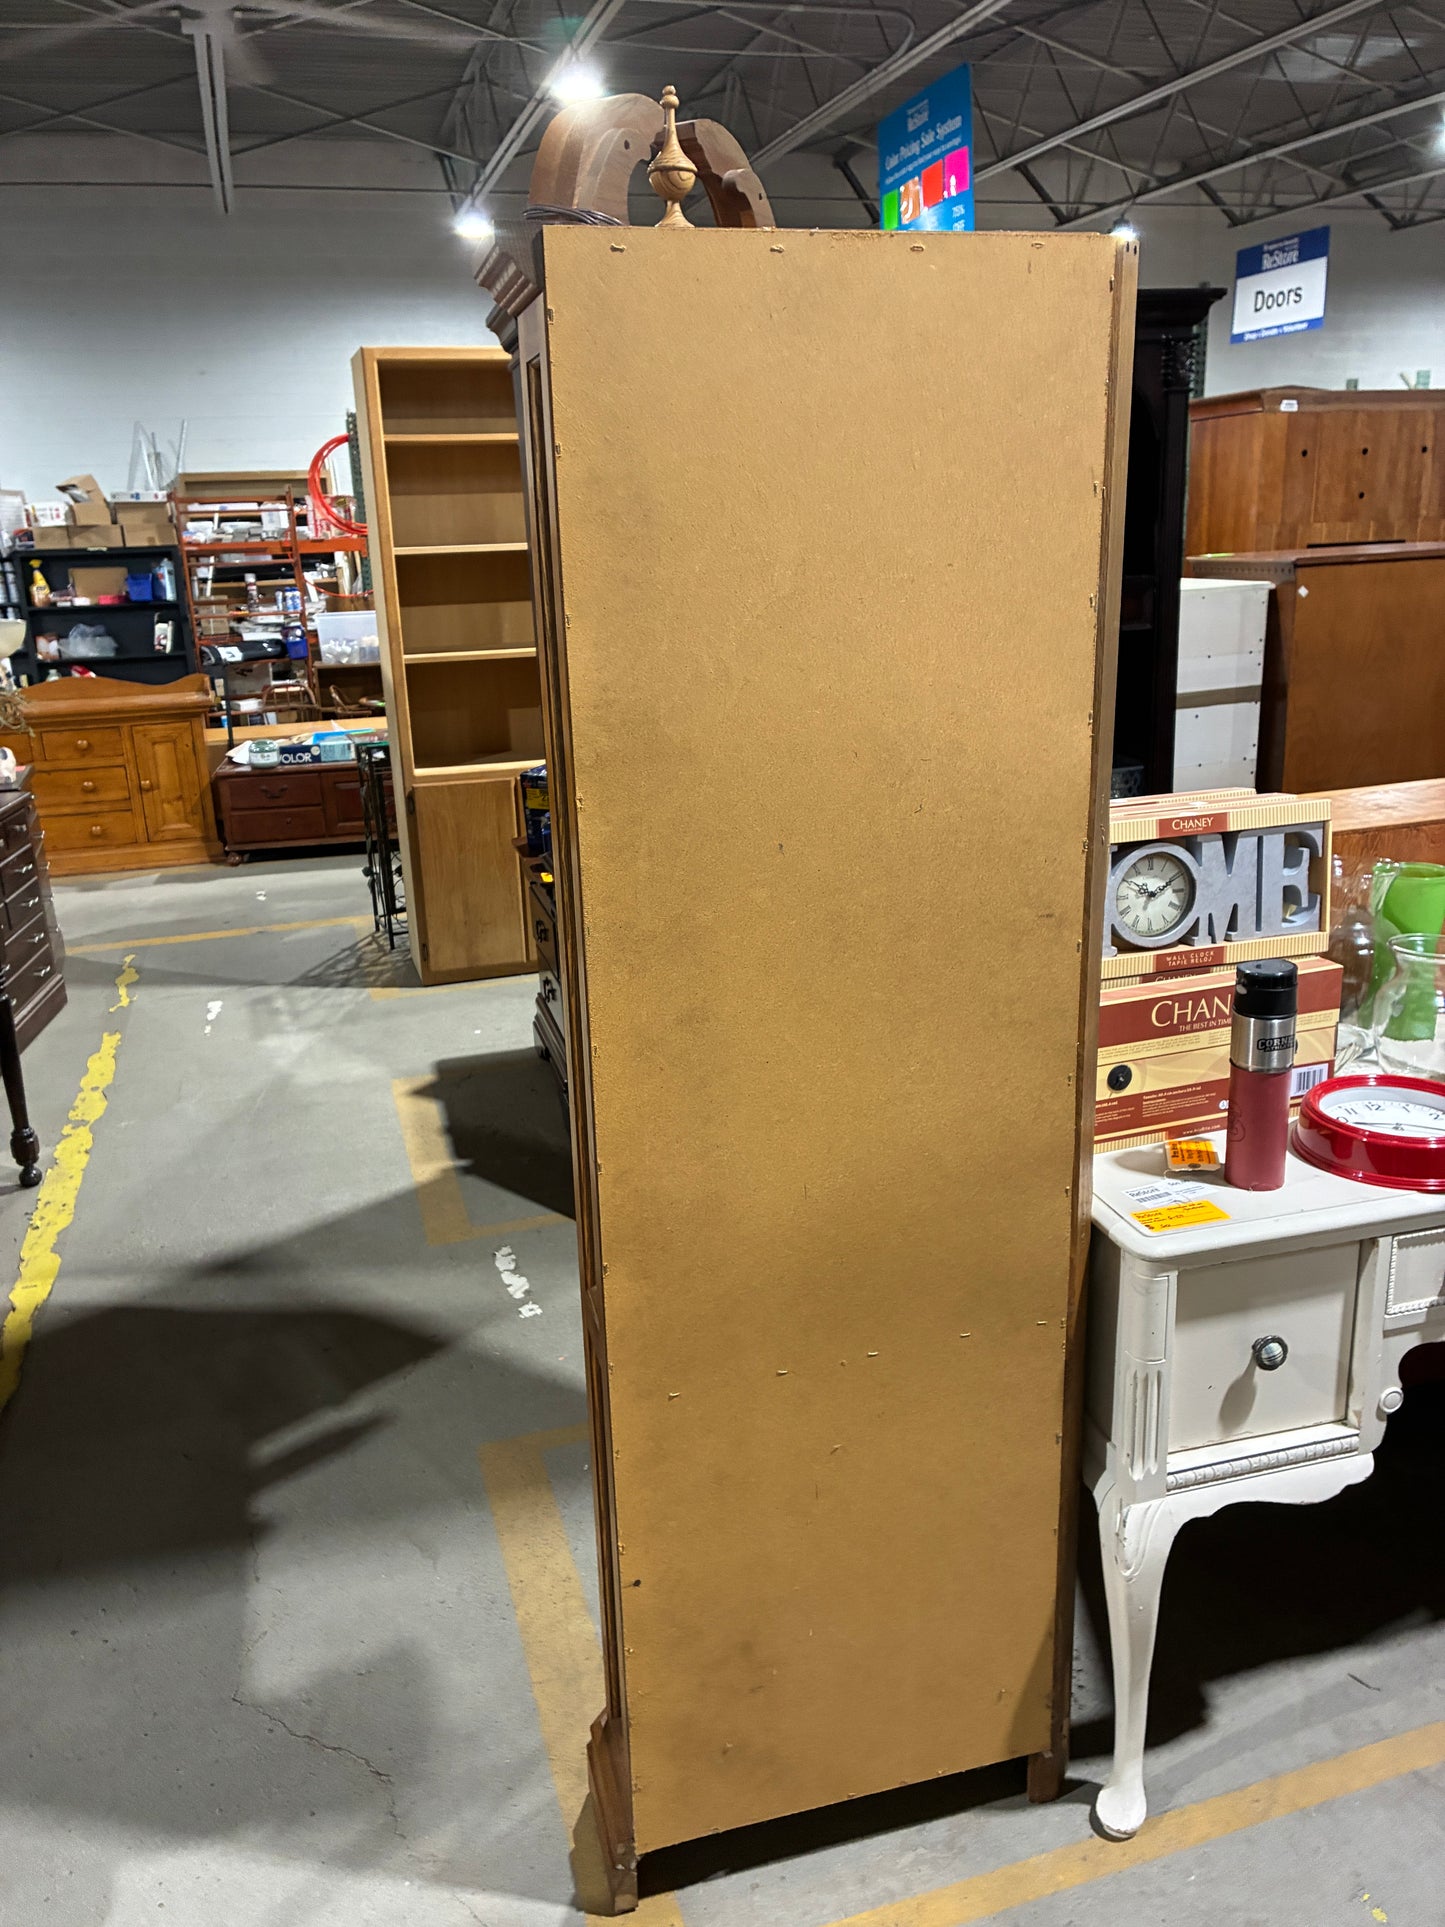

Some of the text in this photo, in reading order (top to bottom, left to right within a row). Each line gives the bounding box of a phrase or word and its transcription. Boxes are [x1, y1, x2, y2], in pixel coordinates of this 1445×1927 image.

[1262, 249, 1299, 271] ReStore
[1254, 286, 1303, 313] Doors
[1172, 816, 1214, 831] CHANEY
[1180, 1023, 1192, 1032] THE
[1193, 1020, 1208, 1031] BEST
[1209, 1019, 1217, 1027] IN
